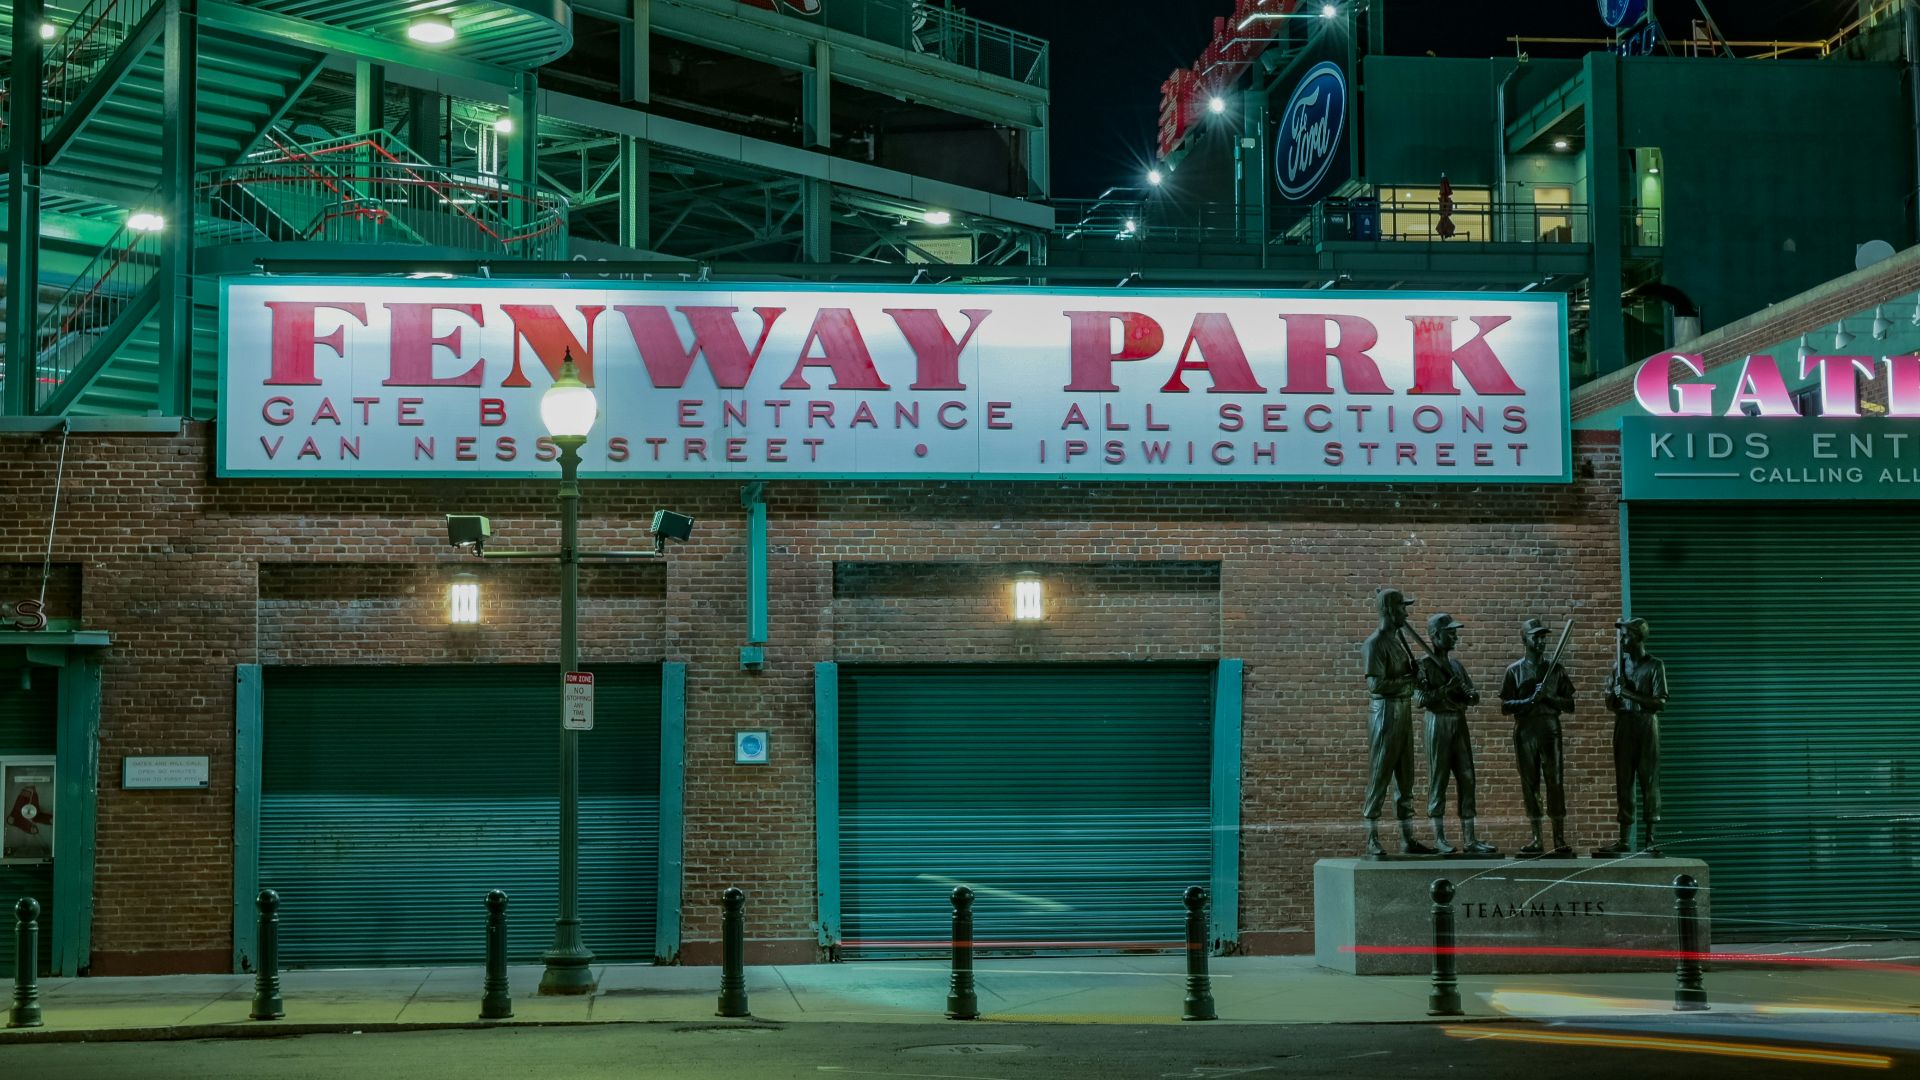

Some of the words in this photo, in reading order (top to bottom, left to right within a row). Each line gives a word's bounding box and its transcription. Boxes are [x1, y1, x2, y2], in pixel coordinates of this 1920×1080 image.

[1287, 85, 1331, 182] Ford
[263, 301, 993, 391] FENWAY
[1063, 310, 1527, 395] PARK
[262, 396, 424, 426] GATE
[479, 398, 508, 426] B
[678, 399, 1014, 430] ENTRANCE
[1061, 402, 1171, 432] ALL
[1219, 403, 1528, 434] SECTIONS
[259, 435, 361, 460] VAN
[414, 436, 557, 461] NESS
[606, 437, 825, 462] STREET
[1039, 439, 1276, 465] IPSWICH
[1323, 441, 1528, 467] STREET
[1650, 432, 1771, 460] KIDS
[1749, 467, 1864, 483] CALLING
[566, 674, 577, 682] TOW
[578, 675, 592, 683] ZONE
[573, 687, 584, 695] NO
[1461, 901, 1605, 918] TEAMMATES
